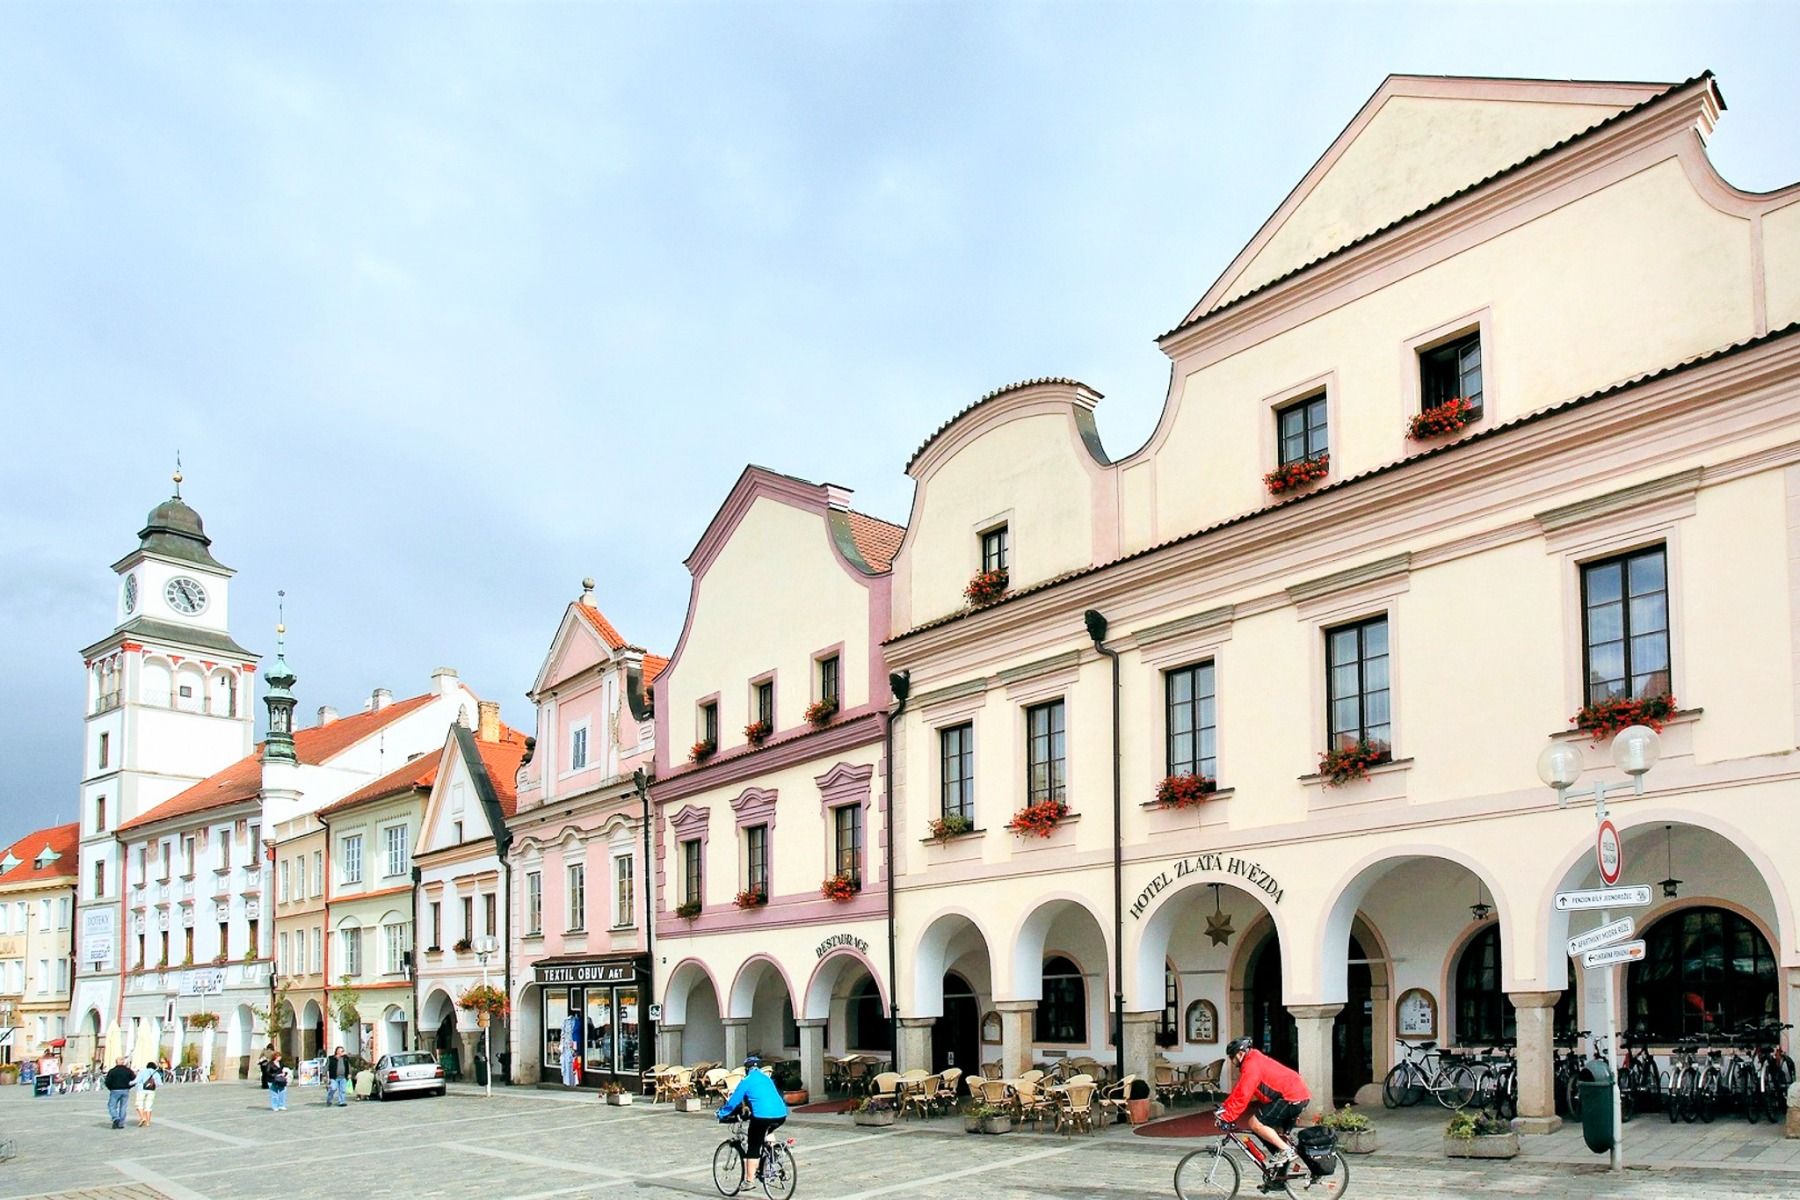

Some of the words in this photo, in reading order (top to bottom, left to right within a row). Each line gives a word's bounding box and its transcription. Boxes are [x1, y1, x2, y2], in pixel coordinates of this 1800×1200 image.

[1129, 871, 1173, 920] HOTEL
[1174, 852, 1222, 878] ZLATÁ
[1227, 857, 1285, 904] HVĚZDA
[815, 933, 869, 958] RESTAURACE
[544, 968, 573, 981] TEXTIL
[578, 966, 604, 980] OBUV
